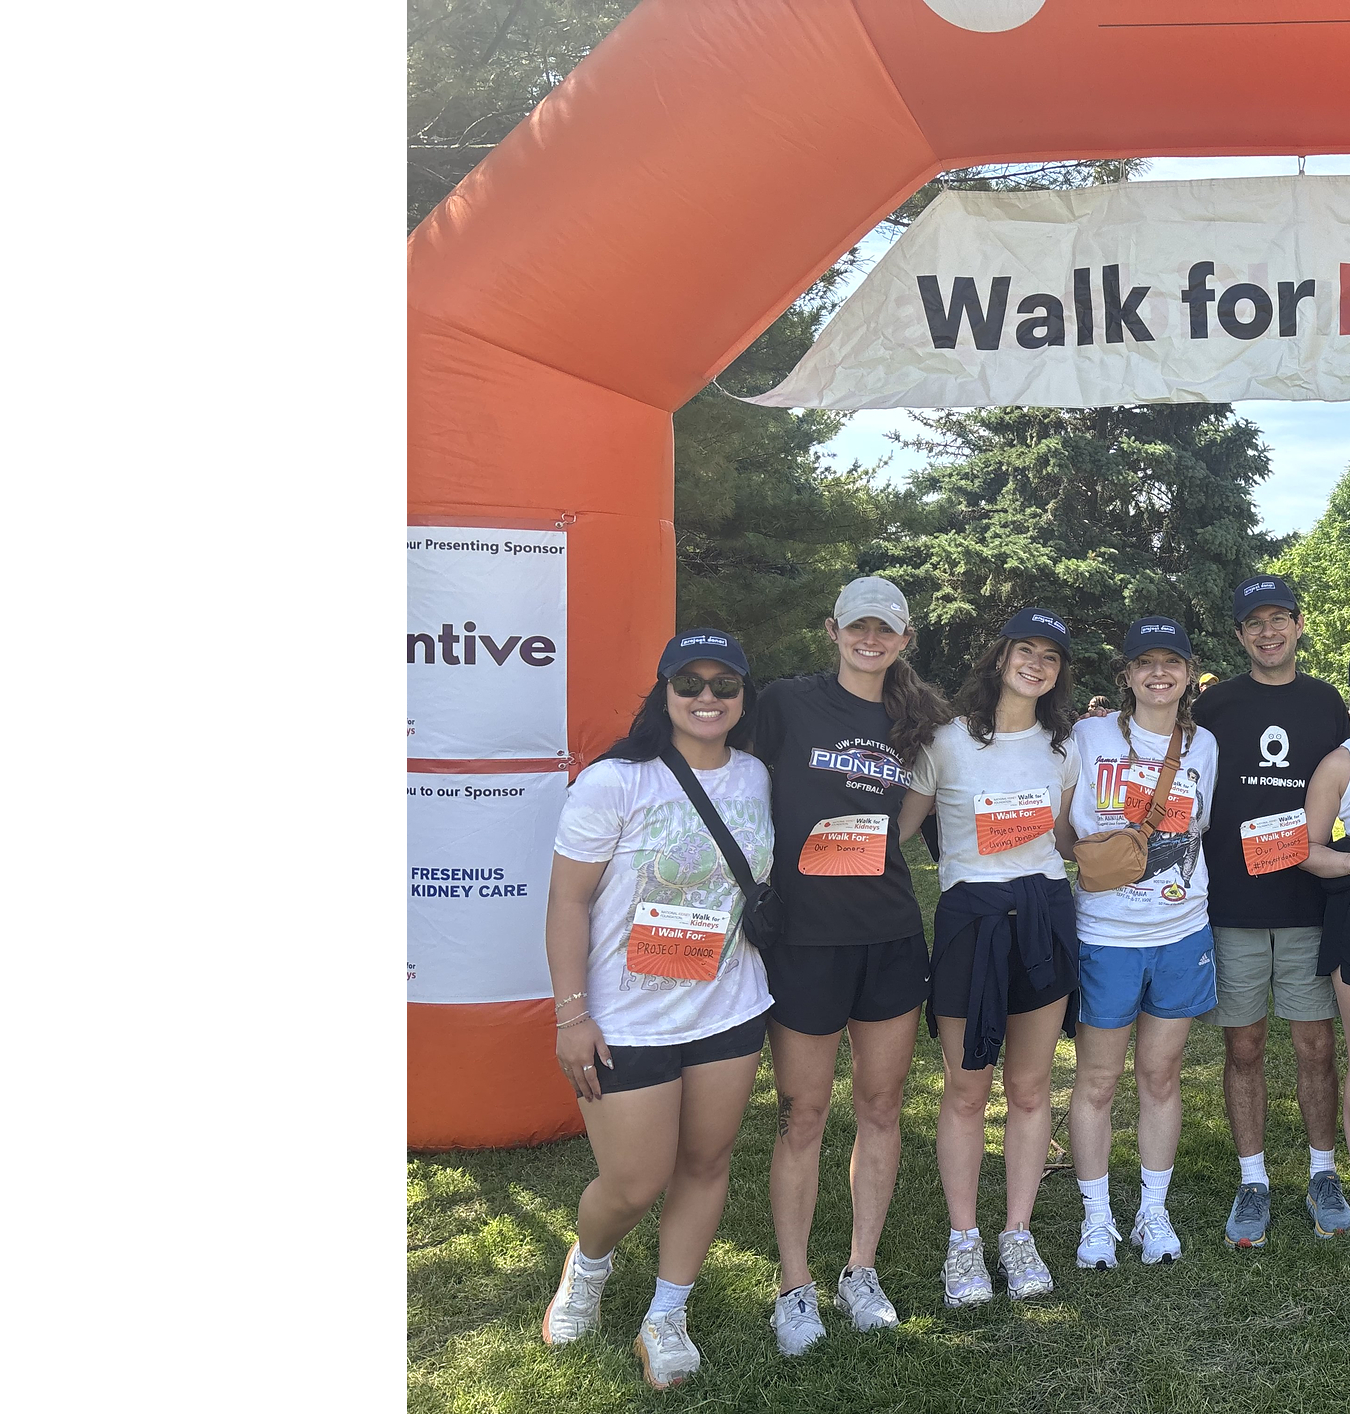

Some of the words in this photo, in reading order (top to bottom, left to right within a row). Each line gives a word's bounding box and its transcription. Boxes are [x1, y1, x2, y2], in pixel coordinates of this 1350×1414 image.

[916, 264, 1154, 350] Walk
[1181, 260, 1316, 339] for
[426, 539, 499, 554] Presenting
[504, 542, 565, 555] Sponsor
[835, 738, 905, 764] UW-PLATTEVILLE
[1094, 755, 1118, 765] James
[812, 750, 912, 787] PIONEERS
[846, 781, 884, 795] SOFTBALL
[1260, 777, 1306, 788] ROBINSON
[420, 786, 432, 796] to
[437, 788, 460, 797] our
[464, 786, 525, 800] Sponsor
[996, 812, 1017, 820] Walk
[1280, 819, 1300, 828] Kidneys
[990, 827, 1014, 836] Project
[1260, 833, 1280, 842] Walk
[990, 839, 1012, 848] Living
[1256, 847, 1272, 856] Our
[1277, 839, 1301, 850] Donors
[412, 868, 504, 881] FRESENIUS
[412, 884, 473, 897] KIDNEY
[479, 884, 528, 897] CARE
[690, 920, 719, 929] Kidneys
[652, 927, 656, 935] I
[659, 928, 683, 938] Walk
[686, 931, 706, 941] For:
[637, 942, 680, 955] PROJECT
[684, 945, 714, 958] DONOR
